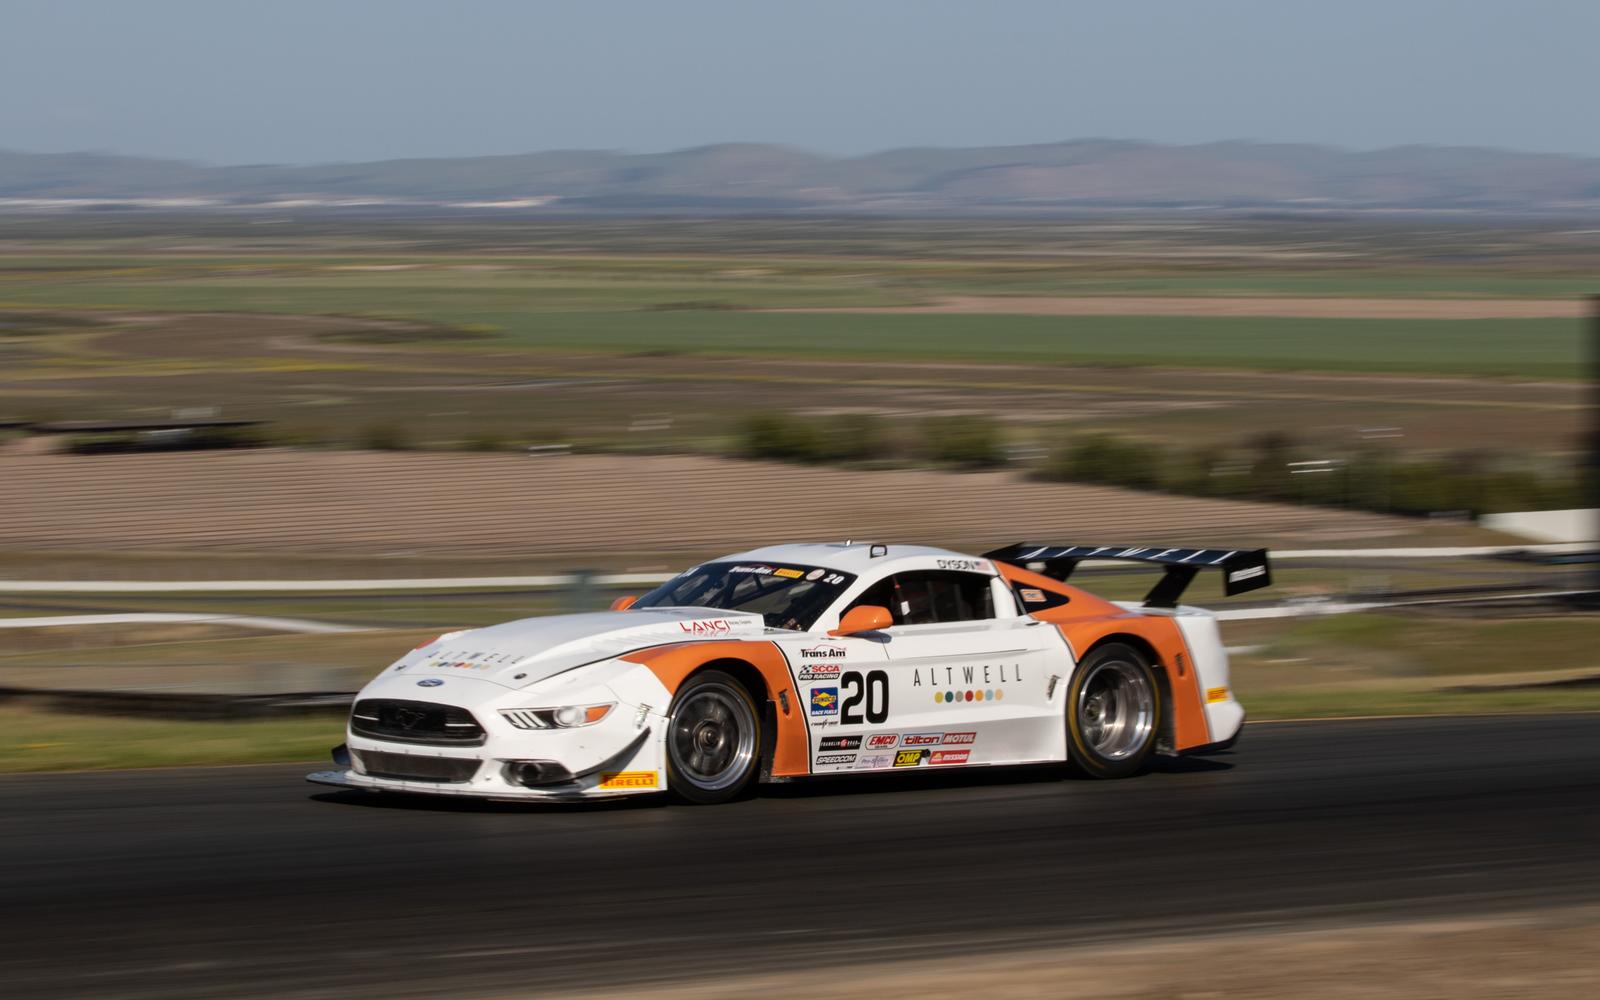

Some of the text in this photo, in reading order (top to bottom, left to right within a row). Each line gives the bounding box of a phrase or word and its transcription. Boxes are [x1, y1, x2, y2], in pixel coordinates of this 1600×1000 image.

[936, 559, 976, 571] DYSON
[822, 573, 845, 585] 20
[679, 619, 731, 632] LANCI
[800, 648, 846, 658] Trans Am
[811, 664, 840, 673] SCCA
[913, 663, 1022, 686] ALTWELL
[840, 670, 890, 725] 20
[869, 735, 897, 746] EMCO
[904, 735, 940, 745] tilton
[943, 734, 975, 744] MOTUL
[816, 755, 857, 764] SPEEDCOM
[896, 753, 921, 763] OMP
[603, 773, 655, 786] PIRELLI
